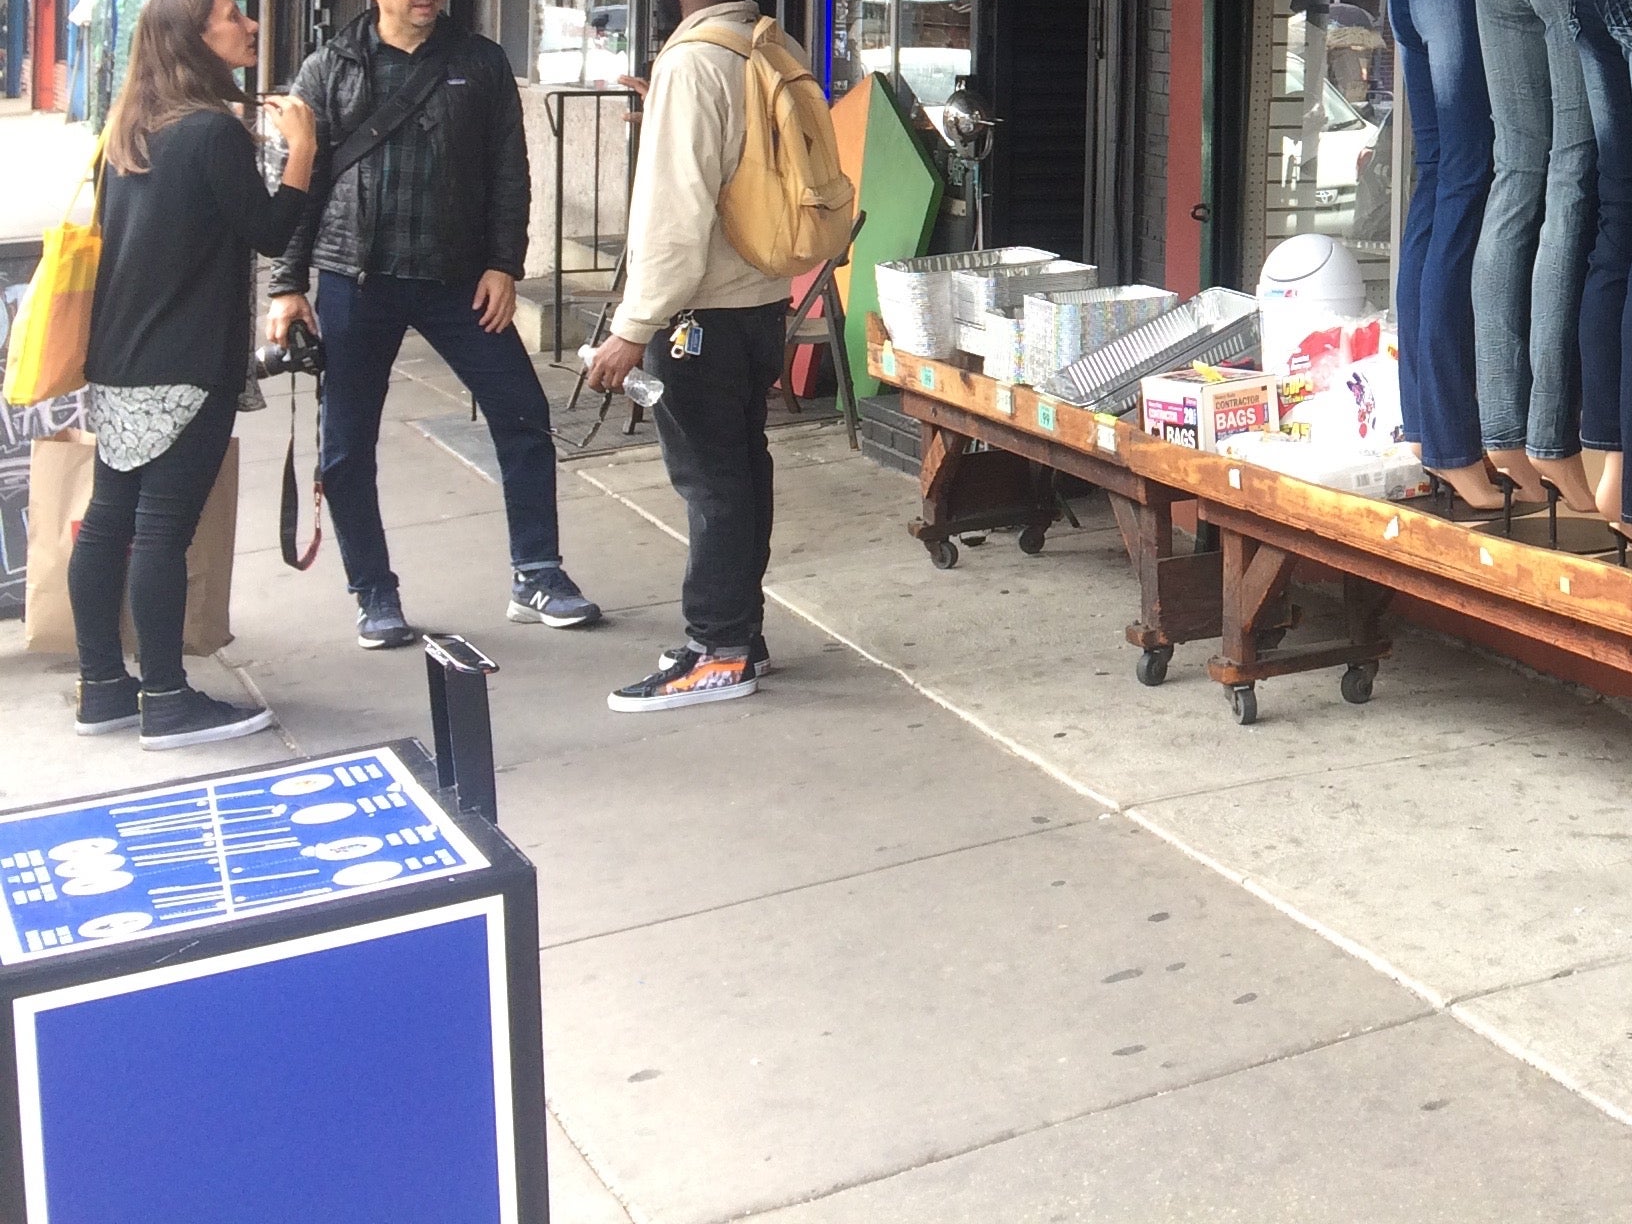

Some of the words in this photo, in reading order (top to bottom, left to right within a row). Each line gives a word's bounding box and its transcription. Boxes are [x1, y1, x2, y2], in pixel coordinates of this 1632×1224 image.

[1215, 394, 1261, 410] CONTRACTOR
[1215, 407, 1257, 431] BAGS
[1166, 425, 1196, 449] BAGS
